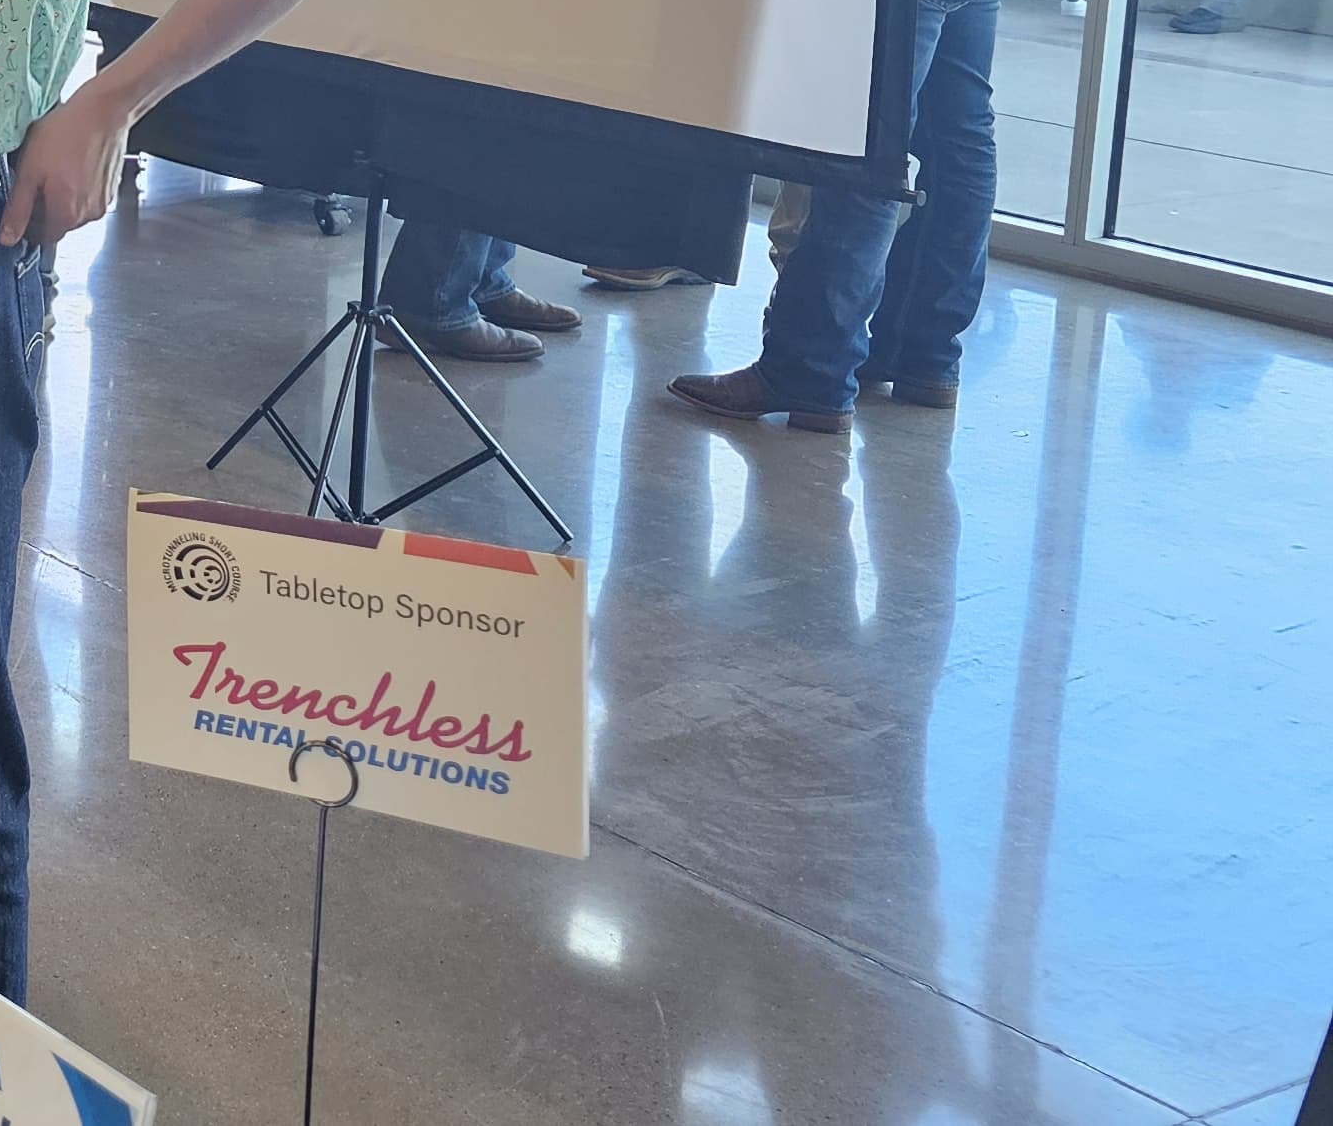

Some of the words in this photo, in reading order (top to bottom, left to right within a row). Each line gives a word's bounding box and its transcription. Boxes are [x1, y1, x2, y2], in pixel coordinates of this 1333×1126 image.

[162, 532, 206, 593] MICROTUNNELING
[209, 535, 236, 562] SHORT
[226, 565, 242, 603] COURSE
[259, 569, 385, 619] Tabletop
[395, 593, 526, 639] Sponsor
[172, 641, 533, 763] Trenchless
[194, 710, 313, 753] RENTAL
[323, 734, 512, 796] SOLUTIONS
